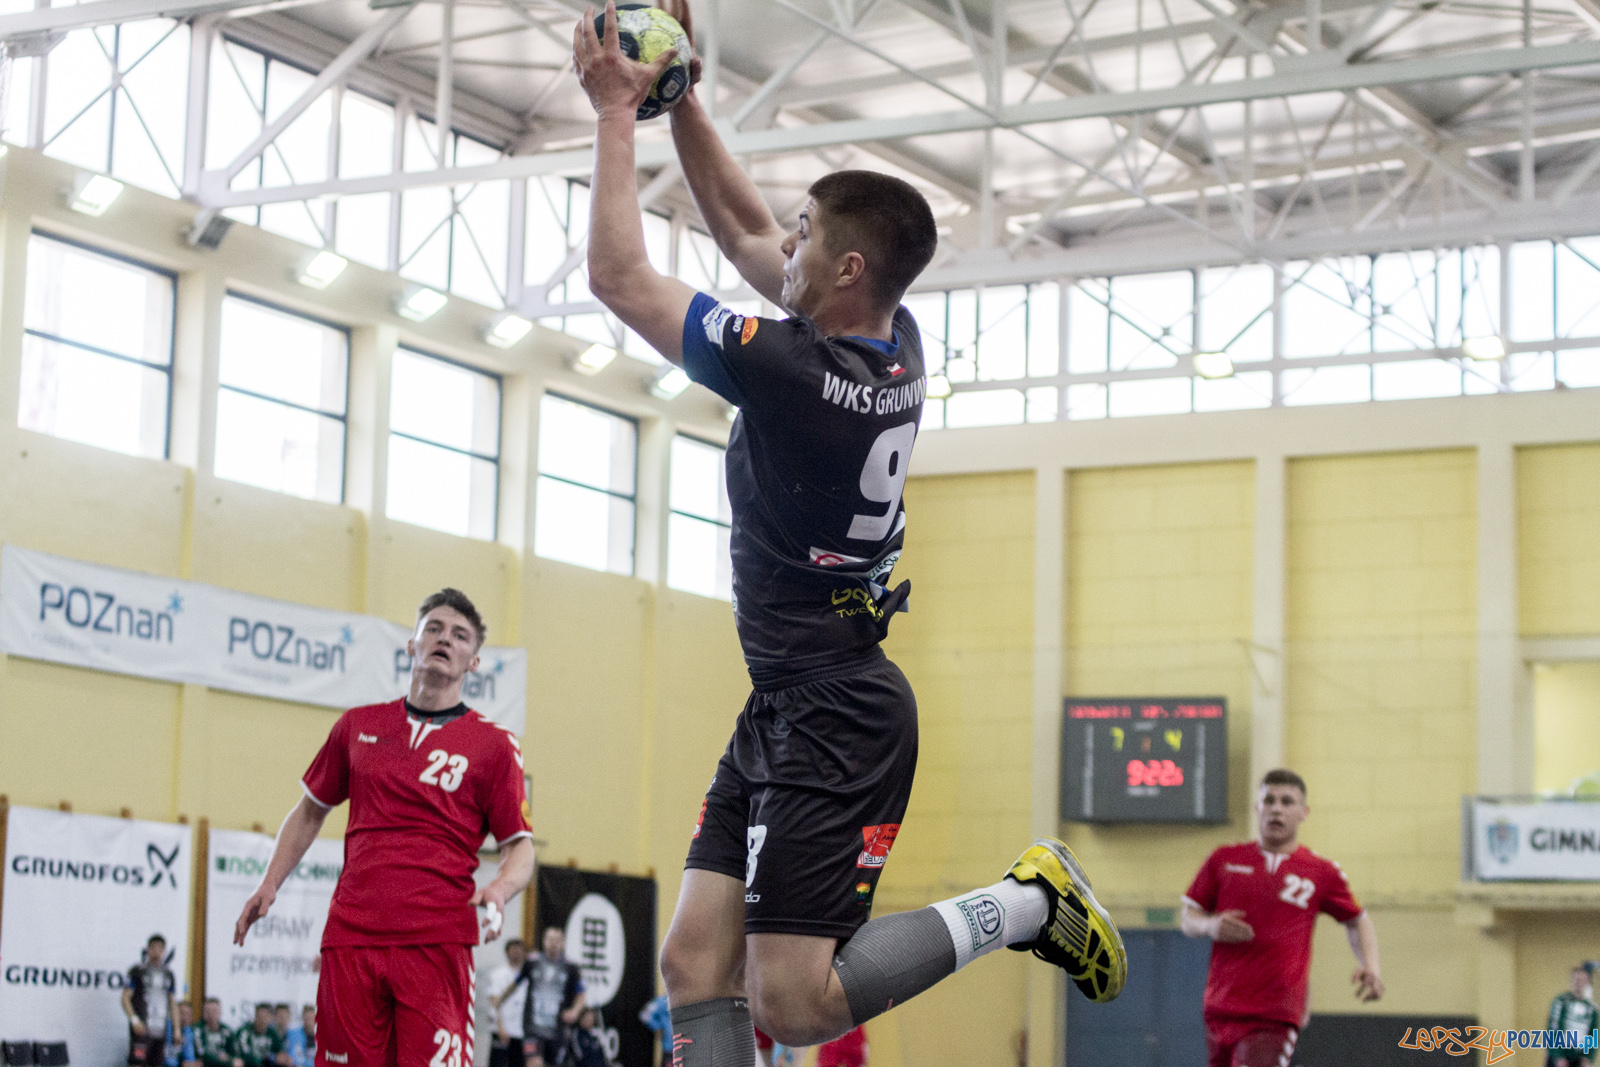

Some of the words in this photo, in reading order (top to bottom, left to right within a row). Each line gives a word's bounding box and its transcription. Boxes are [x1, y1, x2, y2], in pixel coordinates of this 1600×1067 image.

[822, 371, 873, 414] WKS
[847, 422, 915, 541] 9
[419, 749, 469, 793] 23
[1530, 828, 1600, 852] GIMN
[12, 855, 145, 886] GRUNDFOS
[1279, 873, 1316, 910] 22
[5, 965, 125, 990] GRUNDFO
[429, 1028, 463, 1067] 23
